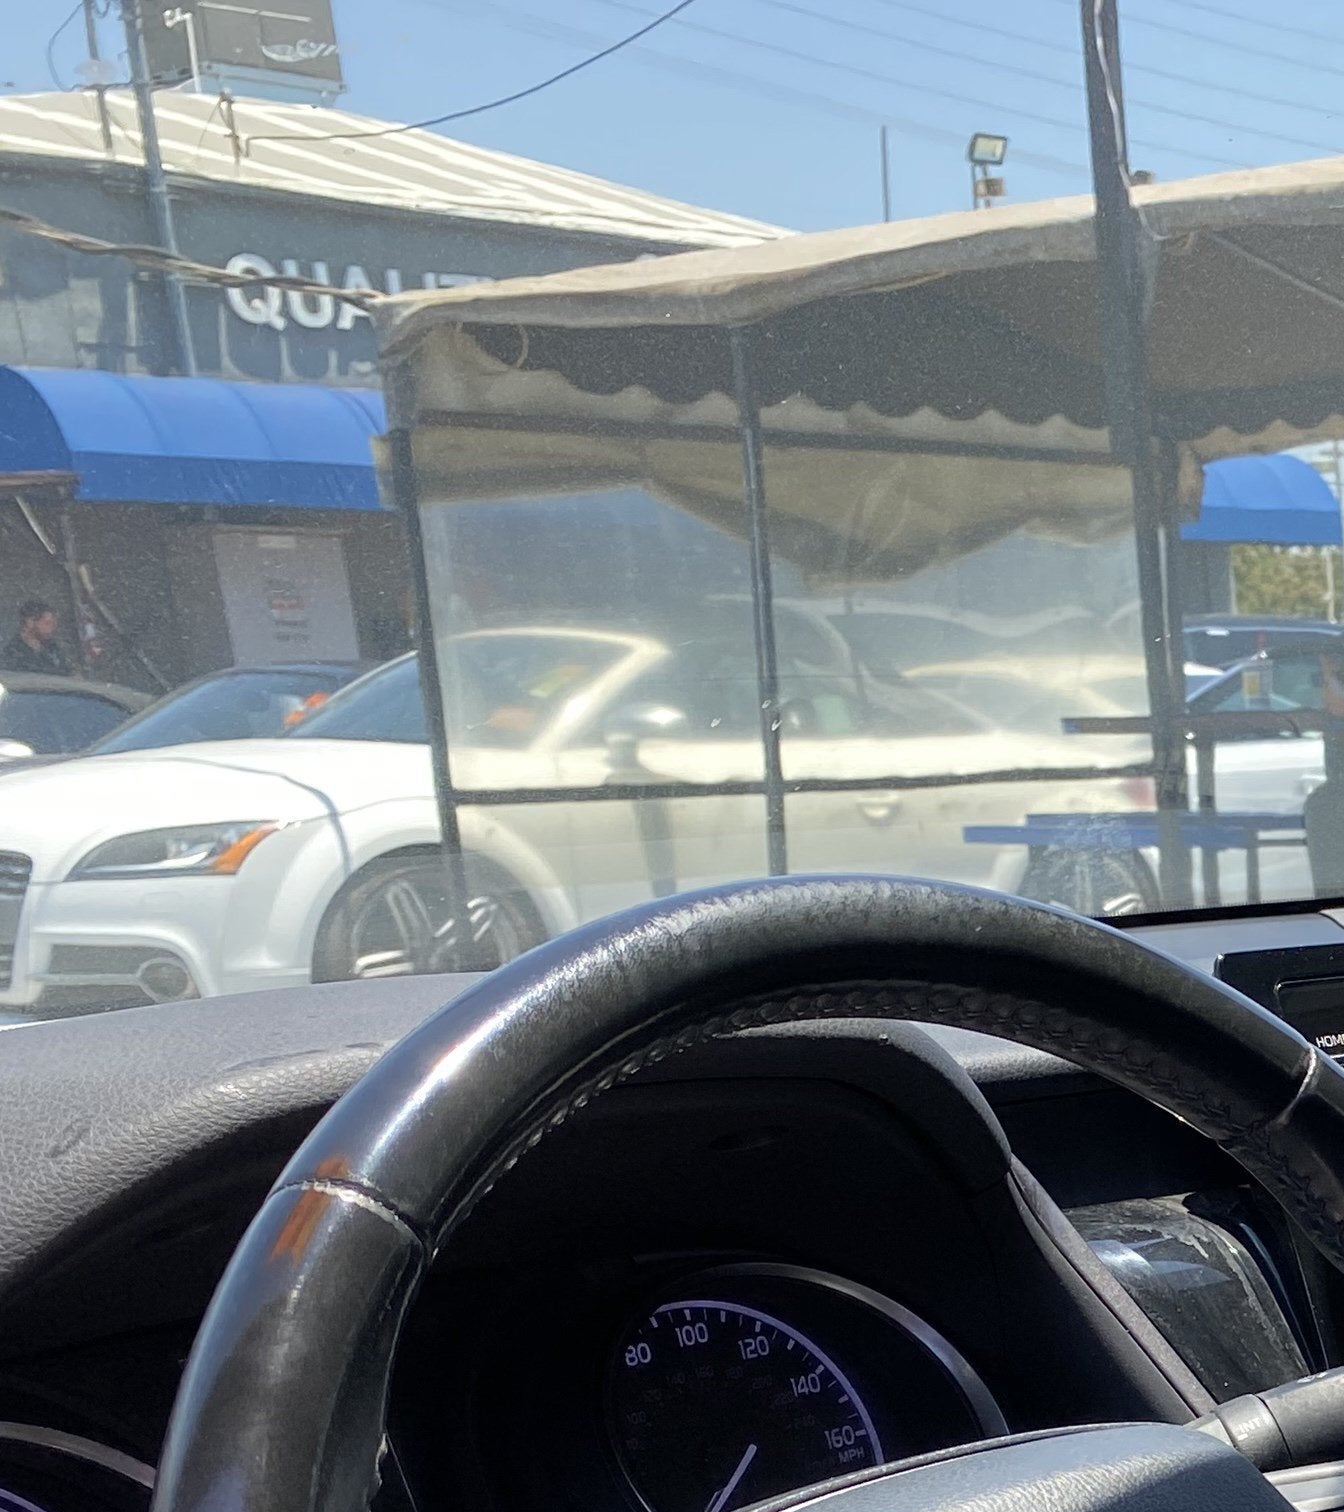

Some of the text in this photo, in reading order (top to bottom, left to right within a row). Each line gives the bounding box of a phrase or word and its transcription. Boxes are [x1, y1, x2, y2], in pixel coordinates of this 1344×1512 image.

[674, 1322, 709, 1348] 100
[625, 1342, 651, 1367] 80
[737, 1335, 769, 1361] 120
[790, 1373, 821, 1397] 140
[824, 1425, 855, 1450] 160
[1239, 1417, 1261, 1433] INT
[837, 1448, 865, 1464] MPH
